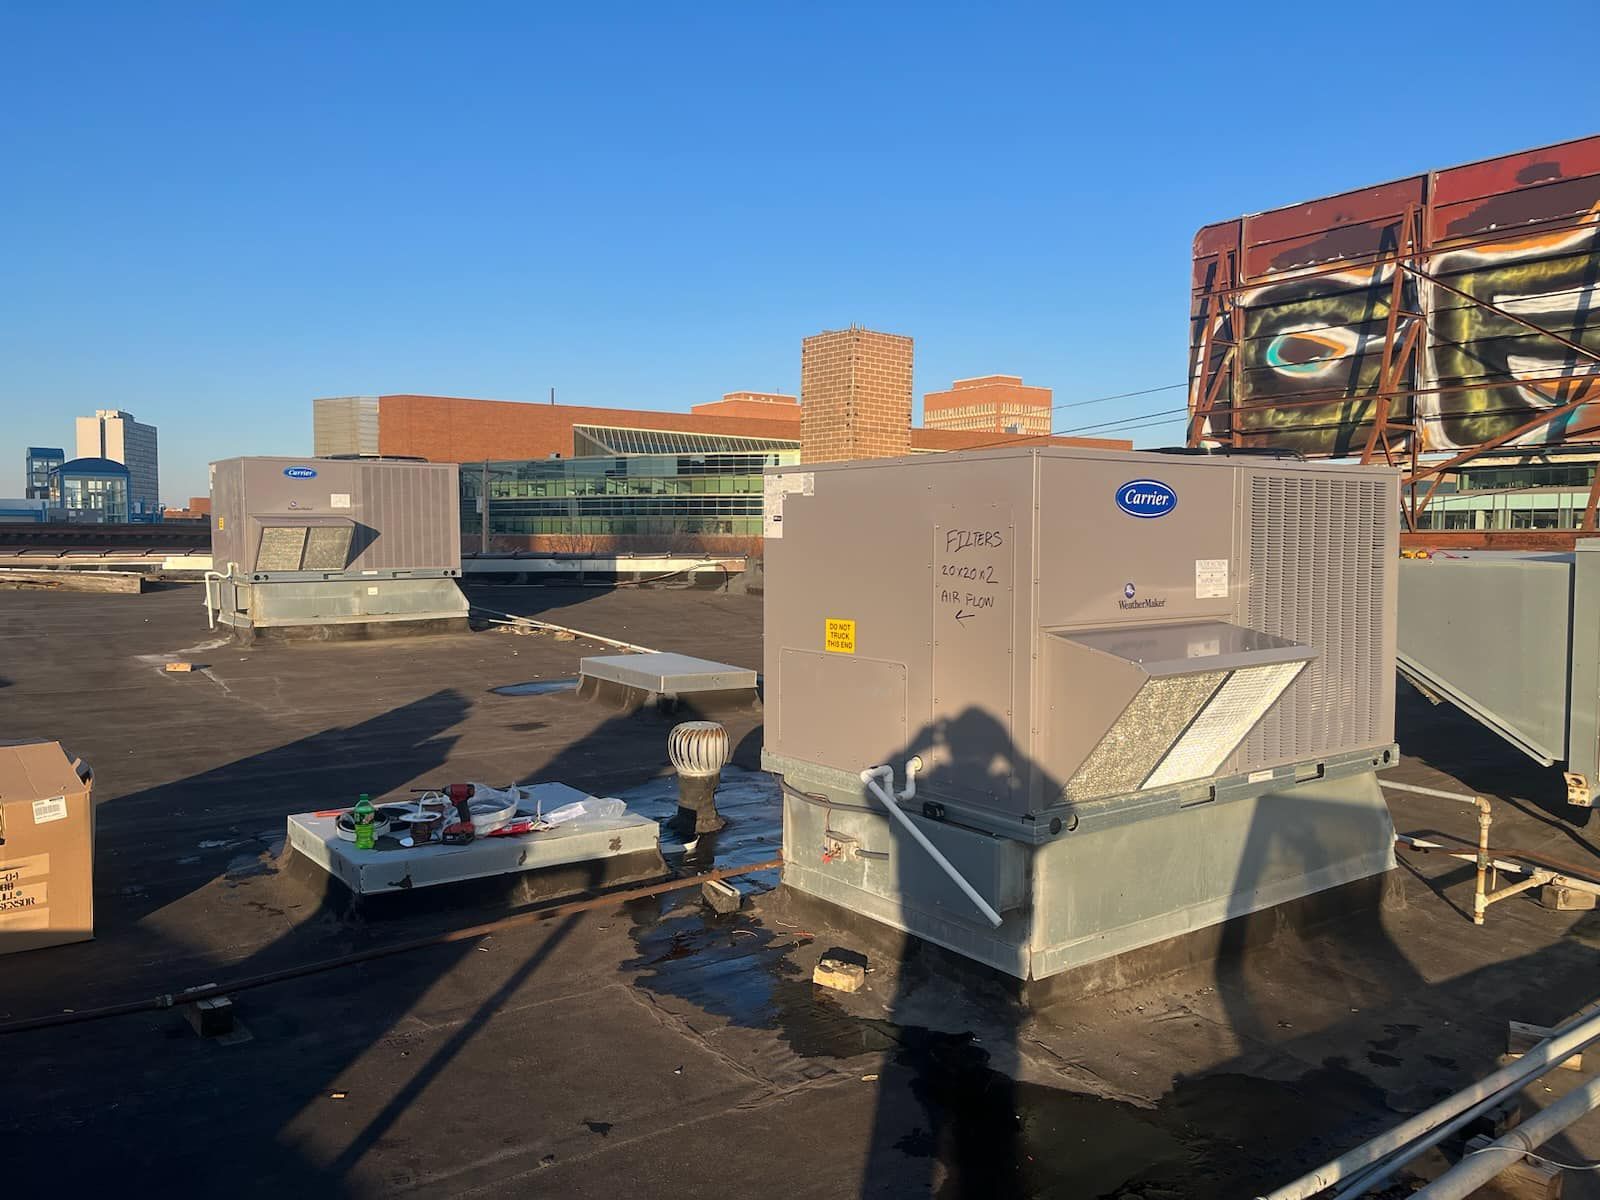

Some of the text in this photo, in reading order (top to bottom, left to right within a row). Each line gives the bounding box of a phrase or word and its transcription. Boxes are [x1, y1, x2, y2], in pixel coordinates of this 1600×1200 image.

[288, 469, 313, 477] Carrier
[1124, 488, 1169, 506] Carrier
[946, 529, 1003, 552] FILTERS
[941, 589, 994, 608] AIR FLOW
[1118, 599, 1165, 610] WeatherMaker
[830, 631, 850, 640] TRUCK
[828, 640, 853, 649] THIS END
